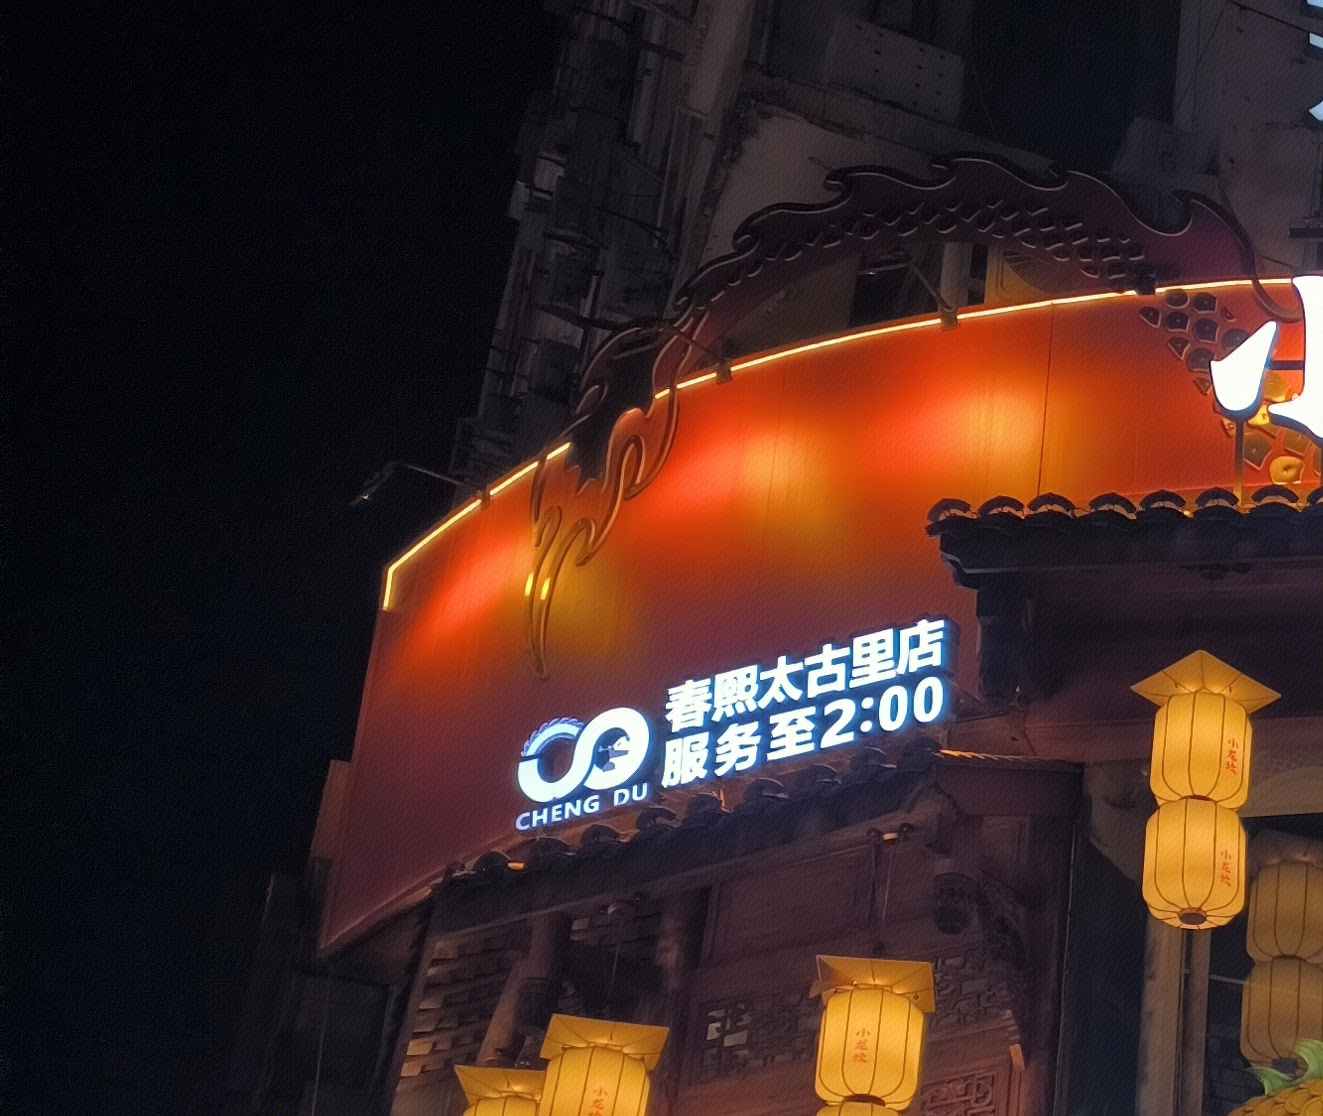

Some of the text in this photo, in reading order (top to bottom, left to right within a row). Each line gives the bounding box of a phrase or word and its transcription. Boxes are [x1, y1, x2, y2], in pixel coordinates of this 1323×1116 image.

[664, 617, 947, 734] 春熙太古里店
[661, 676, 945, 788] 服务至2:00
[515, 782, 650, 832] CHENG DU
